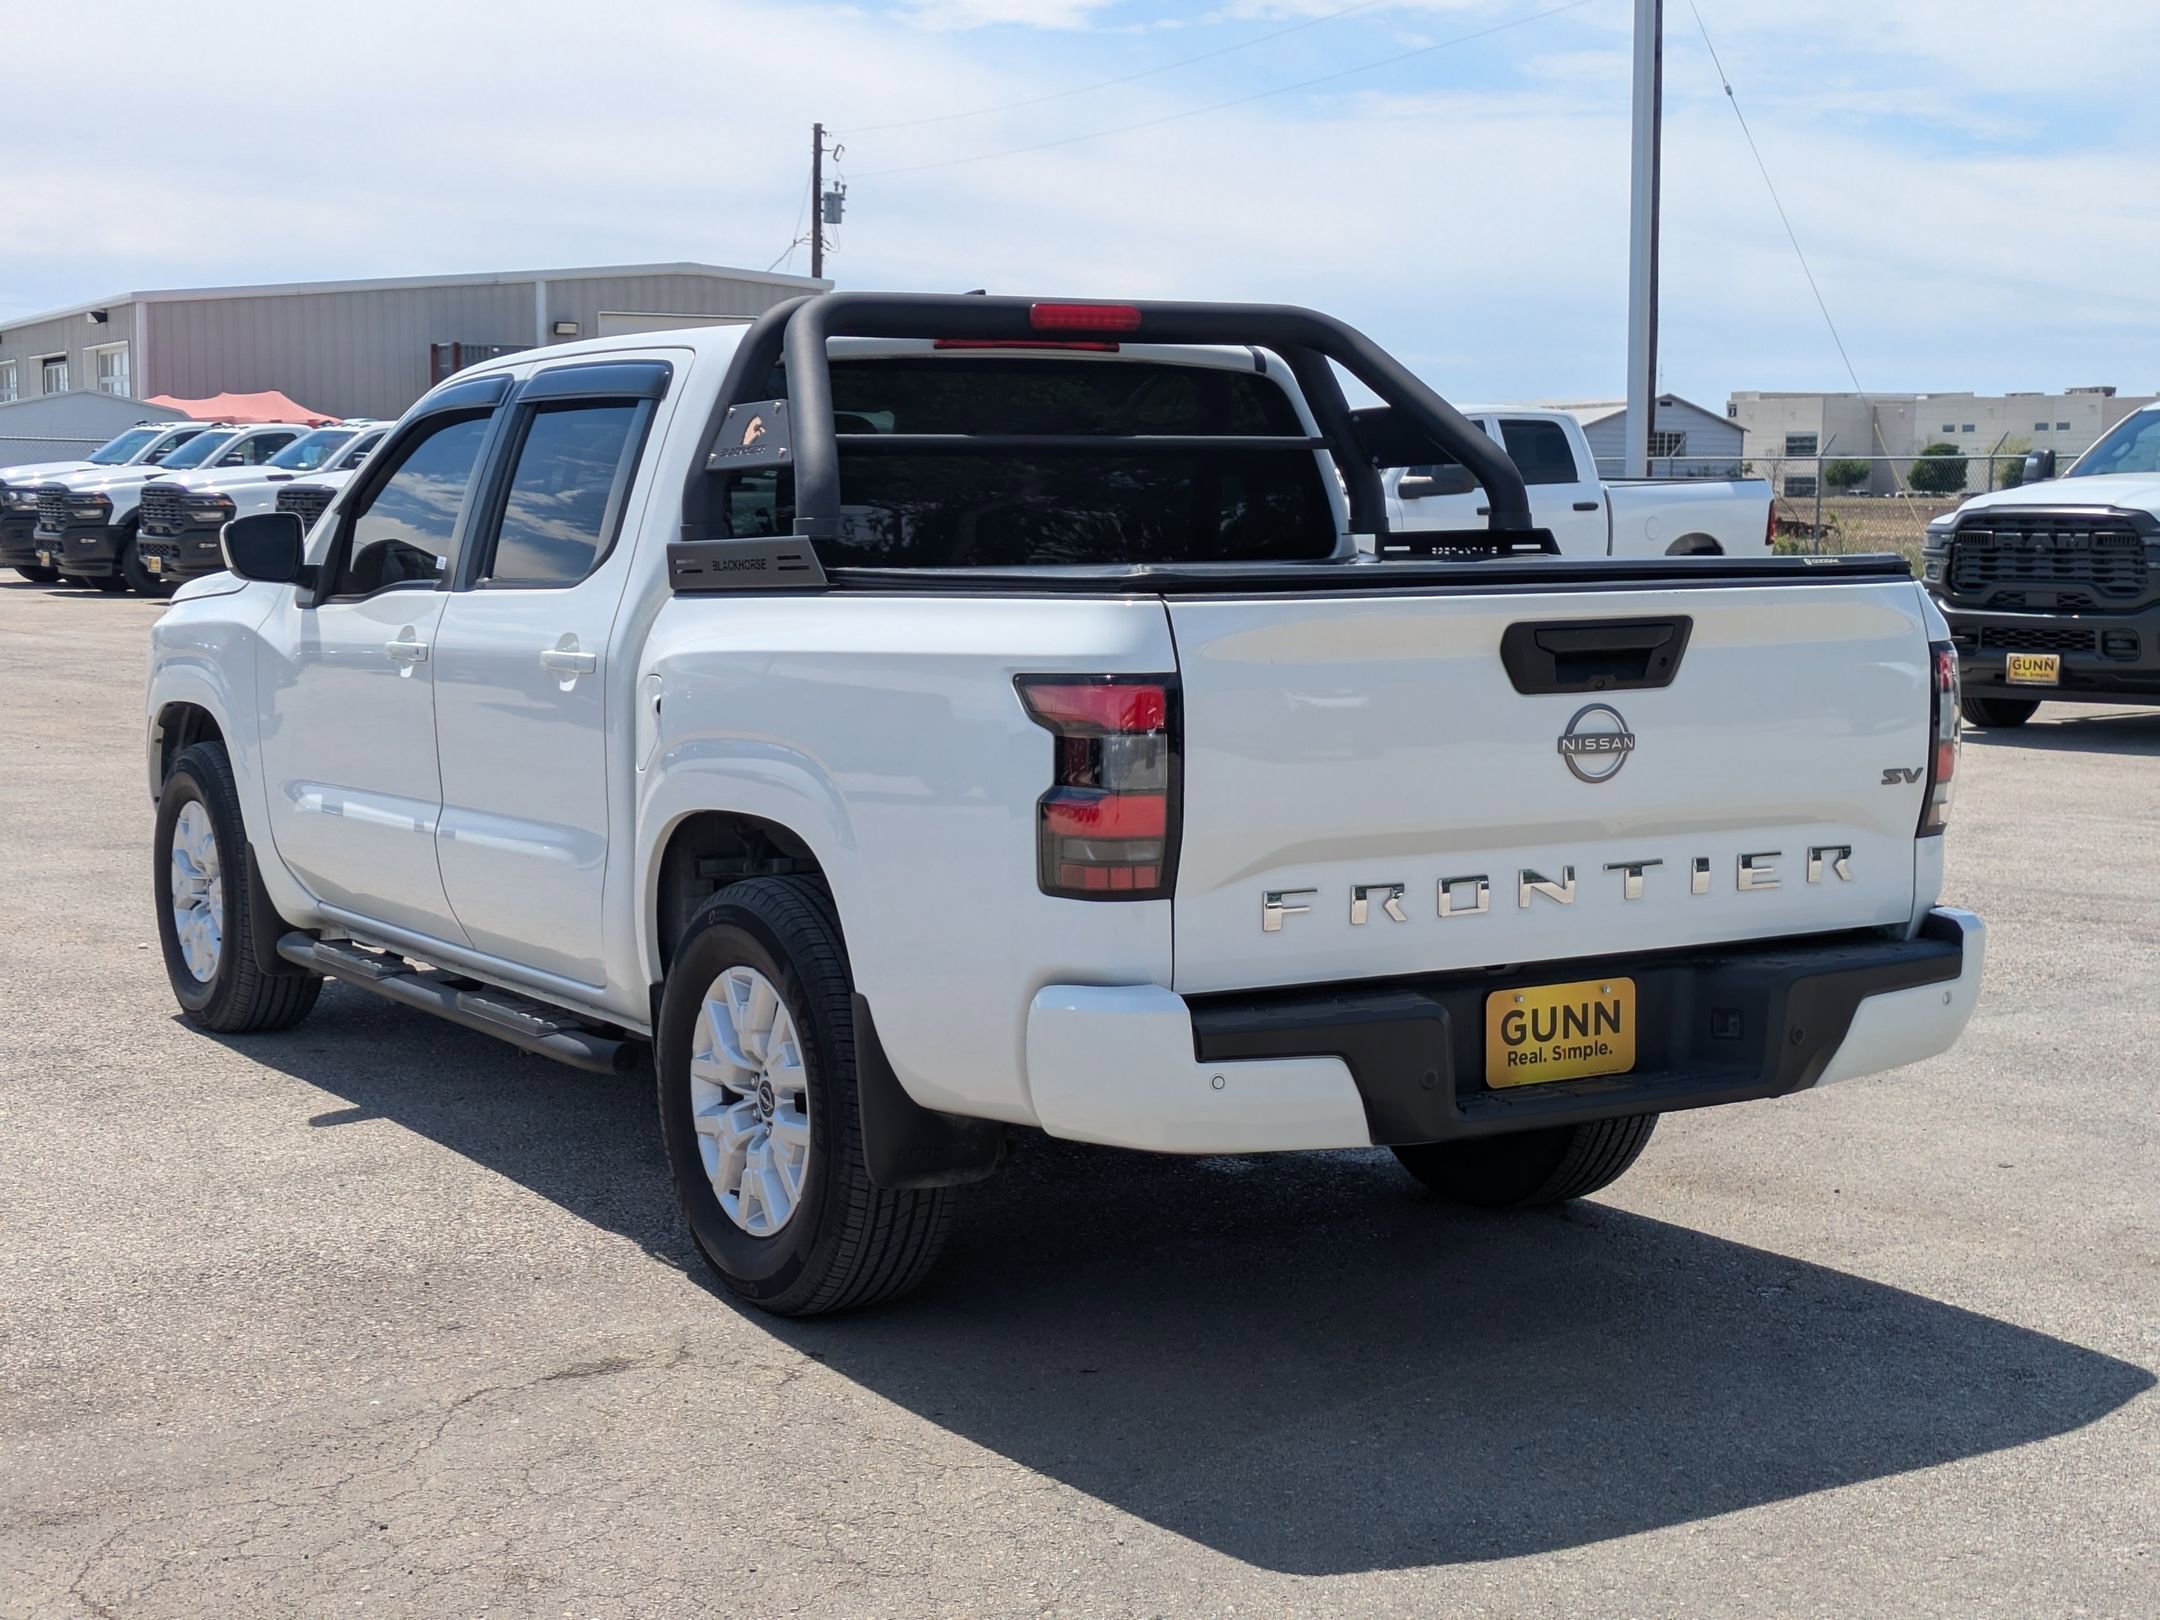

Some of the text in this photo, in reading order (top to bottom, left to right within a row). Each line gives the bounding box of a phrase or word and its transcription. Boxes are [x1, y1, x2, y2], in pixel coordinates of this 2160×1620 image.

[1995, 532, 2090, 549] RAM
[712, 558, 767, 571] BLACKHORSE
[2012, 659, 2055, 671] GUNN
[1562, 738, 1634, 750] NISSAN
[1881, 767, 1924, 785] SV
[1262, 845, 1853, 932] FRONTIER
[1501, 1000, 1621, 1046] GUNN
[1507, 1047, 1547, 1067] Real.
